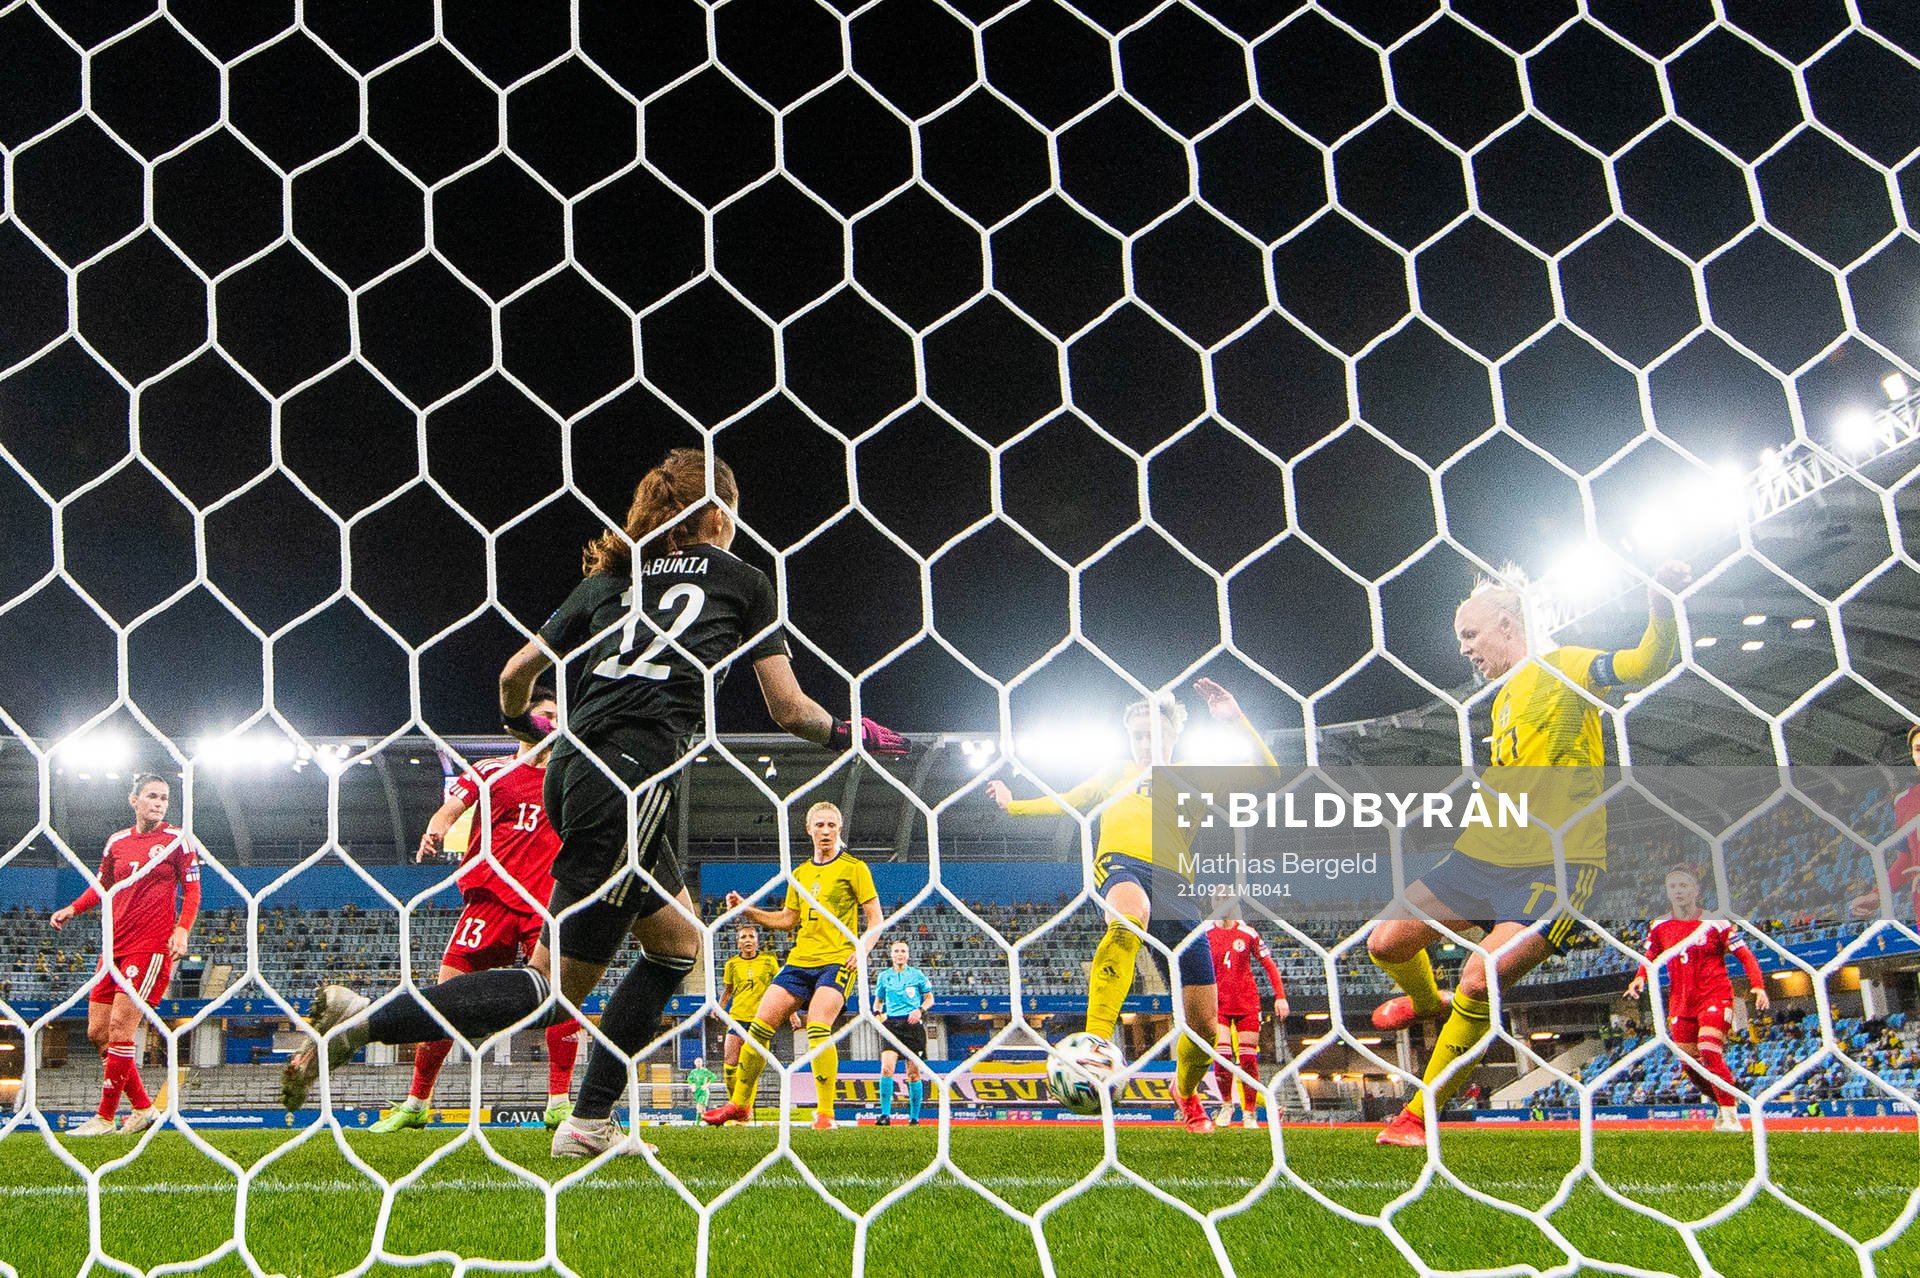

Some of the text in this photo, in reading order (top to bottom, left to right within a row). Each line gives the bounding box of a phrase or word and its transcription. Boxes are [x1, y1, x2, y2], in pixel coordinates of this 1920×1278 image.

[633, 557, 710, 576] ABUNIA
[593, 582, 706, 680] 12
[513, 802, 542, 832] 13
[455, 917, 486, 949] 13
[1223, 951, 1231, 969] 4
[834, 966, 849, 988] 2
[496, 1110, 547, 1124] CAVA
